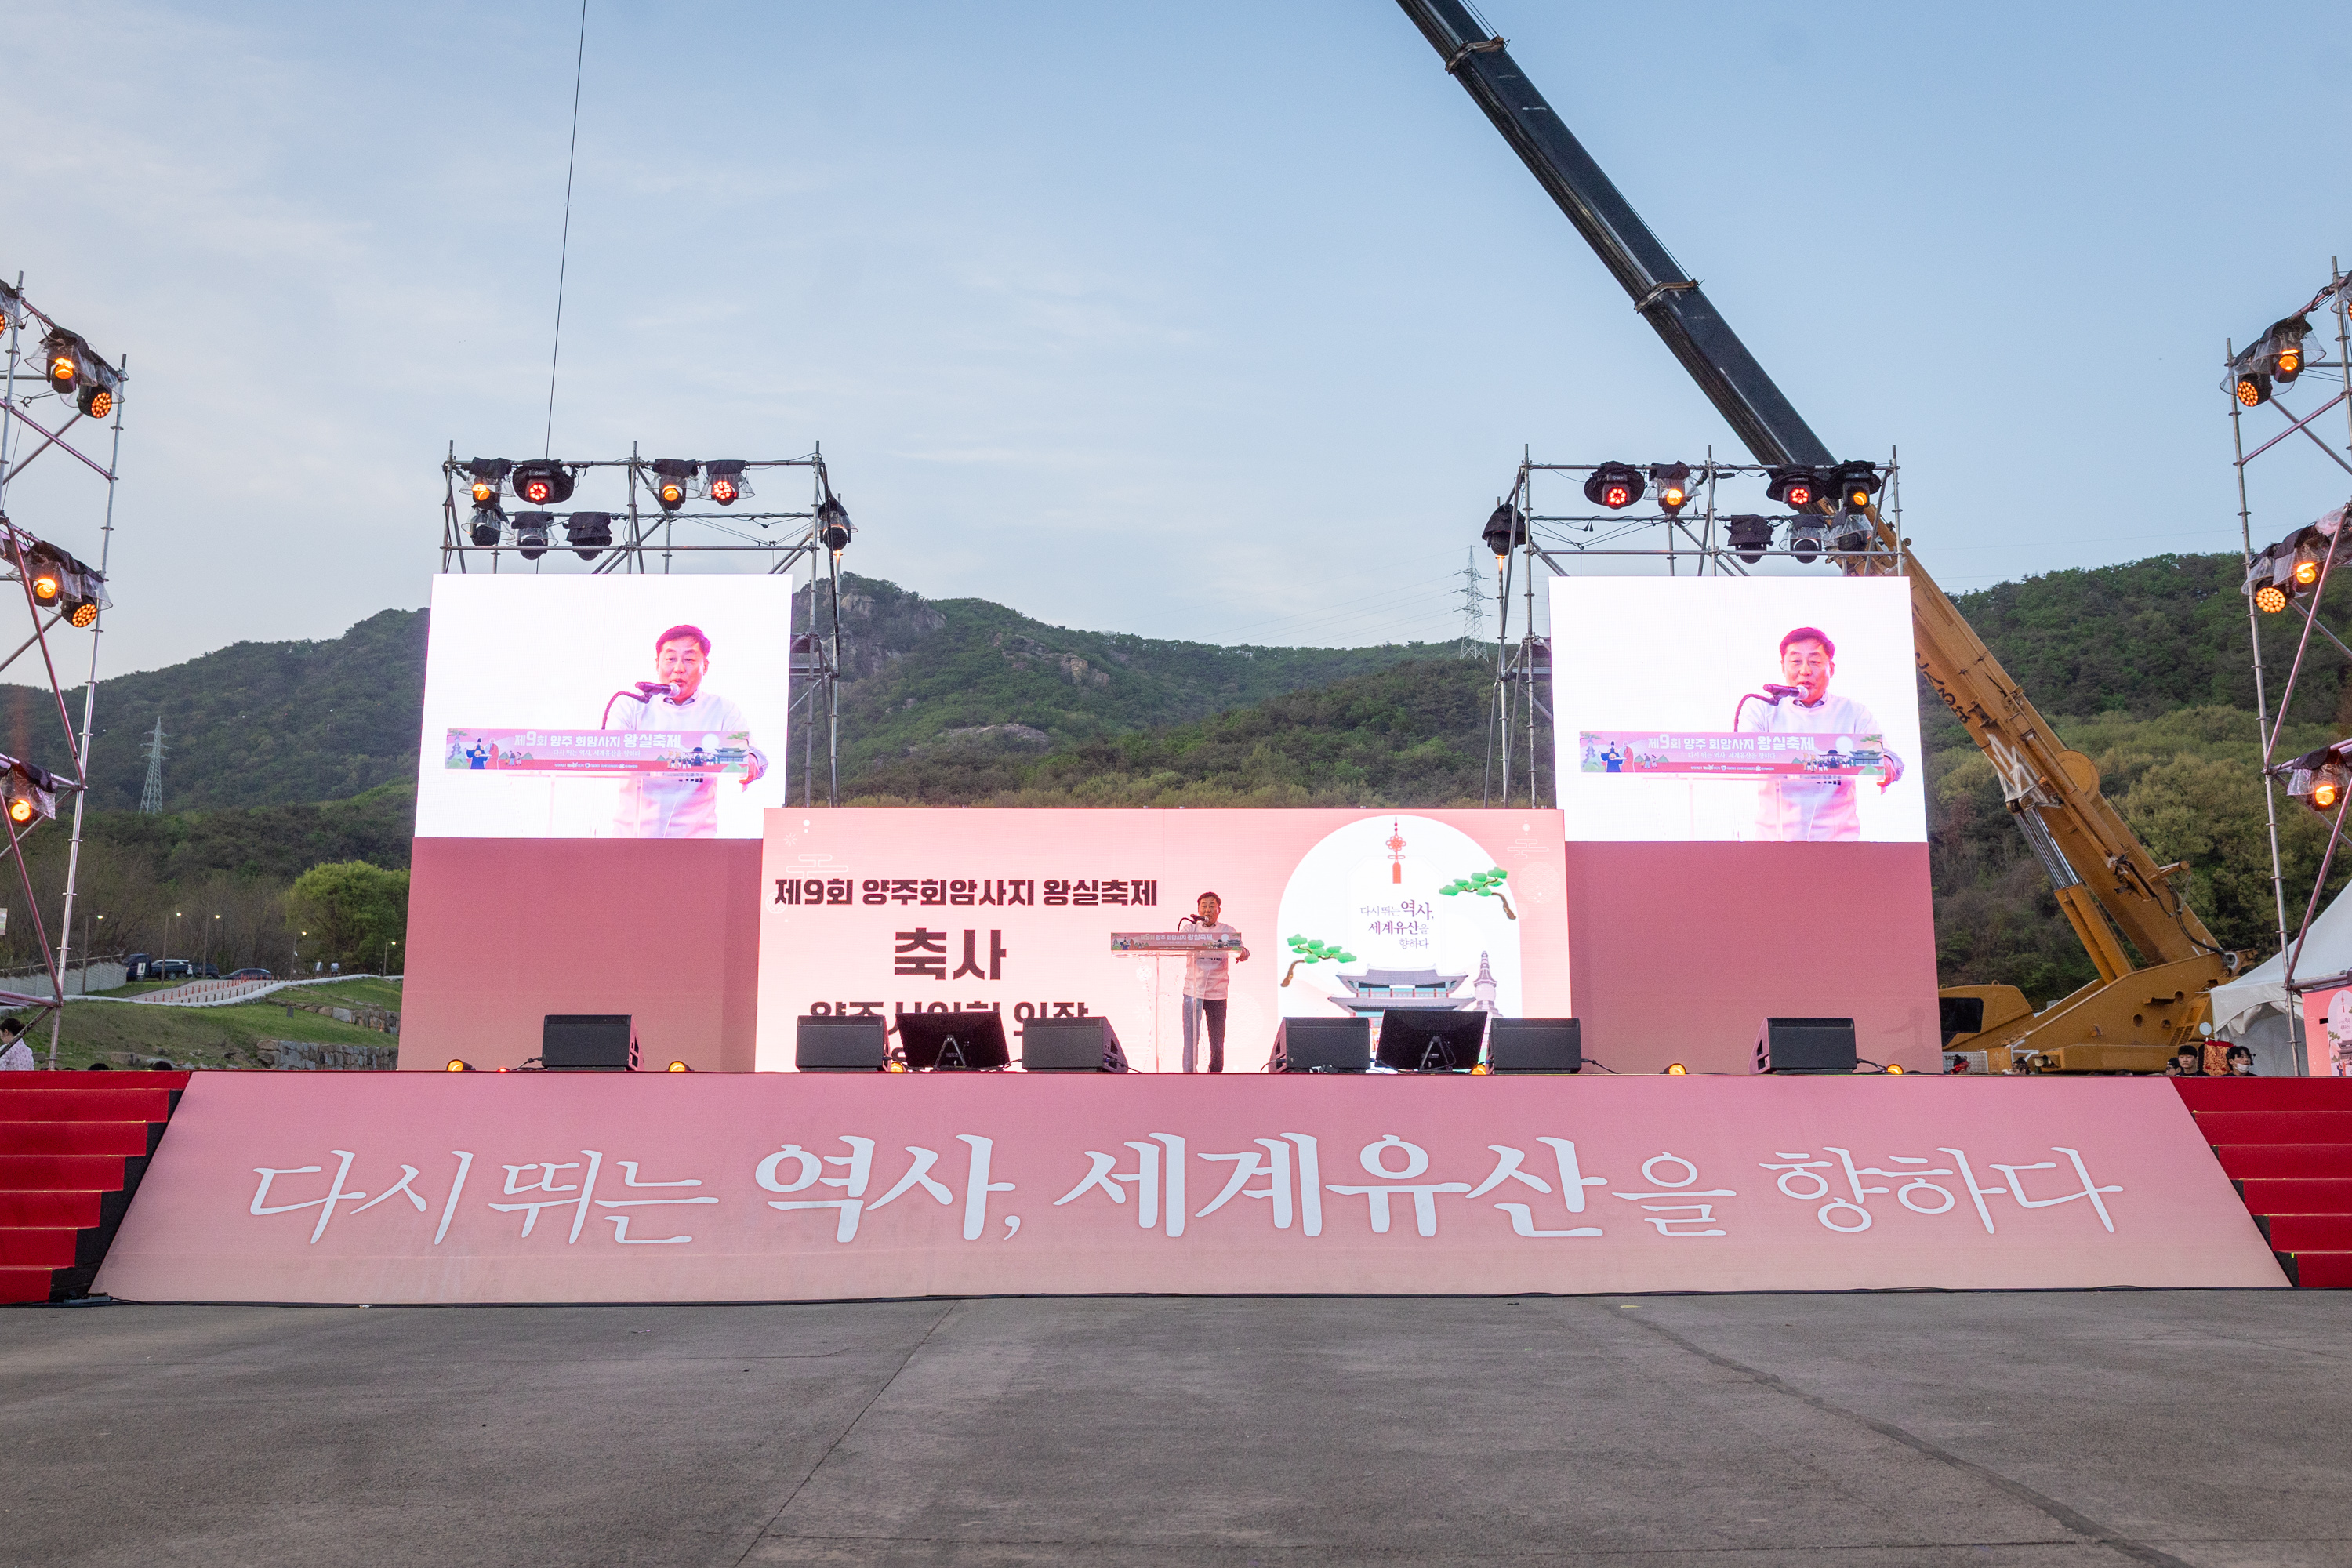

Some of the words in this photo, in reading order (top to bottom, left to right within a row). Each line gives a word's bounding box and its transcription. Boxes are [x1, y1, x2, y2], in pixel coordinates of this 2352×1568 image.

[515, 731, 547, 746] 제9회
[550, 735, 572, 747] 양주
[575, 735, 620, 748] 회암사지
[623, 733, 681, 749] 왕실축제
[1648, 734, 1681, 750] 제9회
[1683, 738, 1706, 750] 양주
[1709, 738, 1754, 750] 회암사지
[1757, 735, 1814, 751] 왕실축제
[775, 879, 854, 906] 제9회
[862, 879, 1034, 906] 양주회암사지
[1043, 880, 1157, 906] 왕실축제
[1360, 906, 1380, 916] 다시
[1381, 906, 1401, 916] 뛰는
[1401, 899, 1434, 920] 역사,
[1368, 920, 1429, 935] 세계유산을
[1399, 938, 1429, 949] 향하다
[895, 927, 1007, 981] 축사
[249, 1150, 474, 1245] 다시
[488, 1149, 719, 1245] 뛰는
[755, 1134, 1021, 1243] 역사,
[1053, 1133, 1736, 1237] 세계유산을
[1758, 1147, 2124, 1235] 향하다
